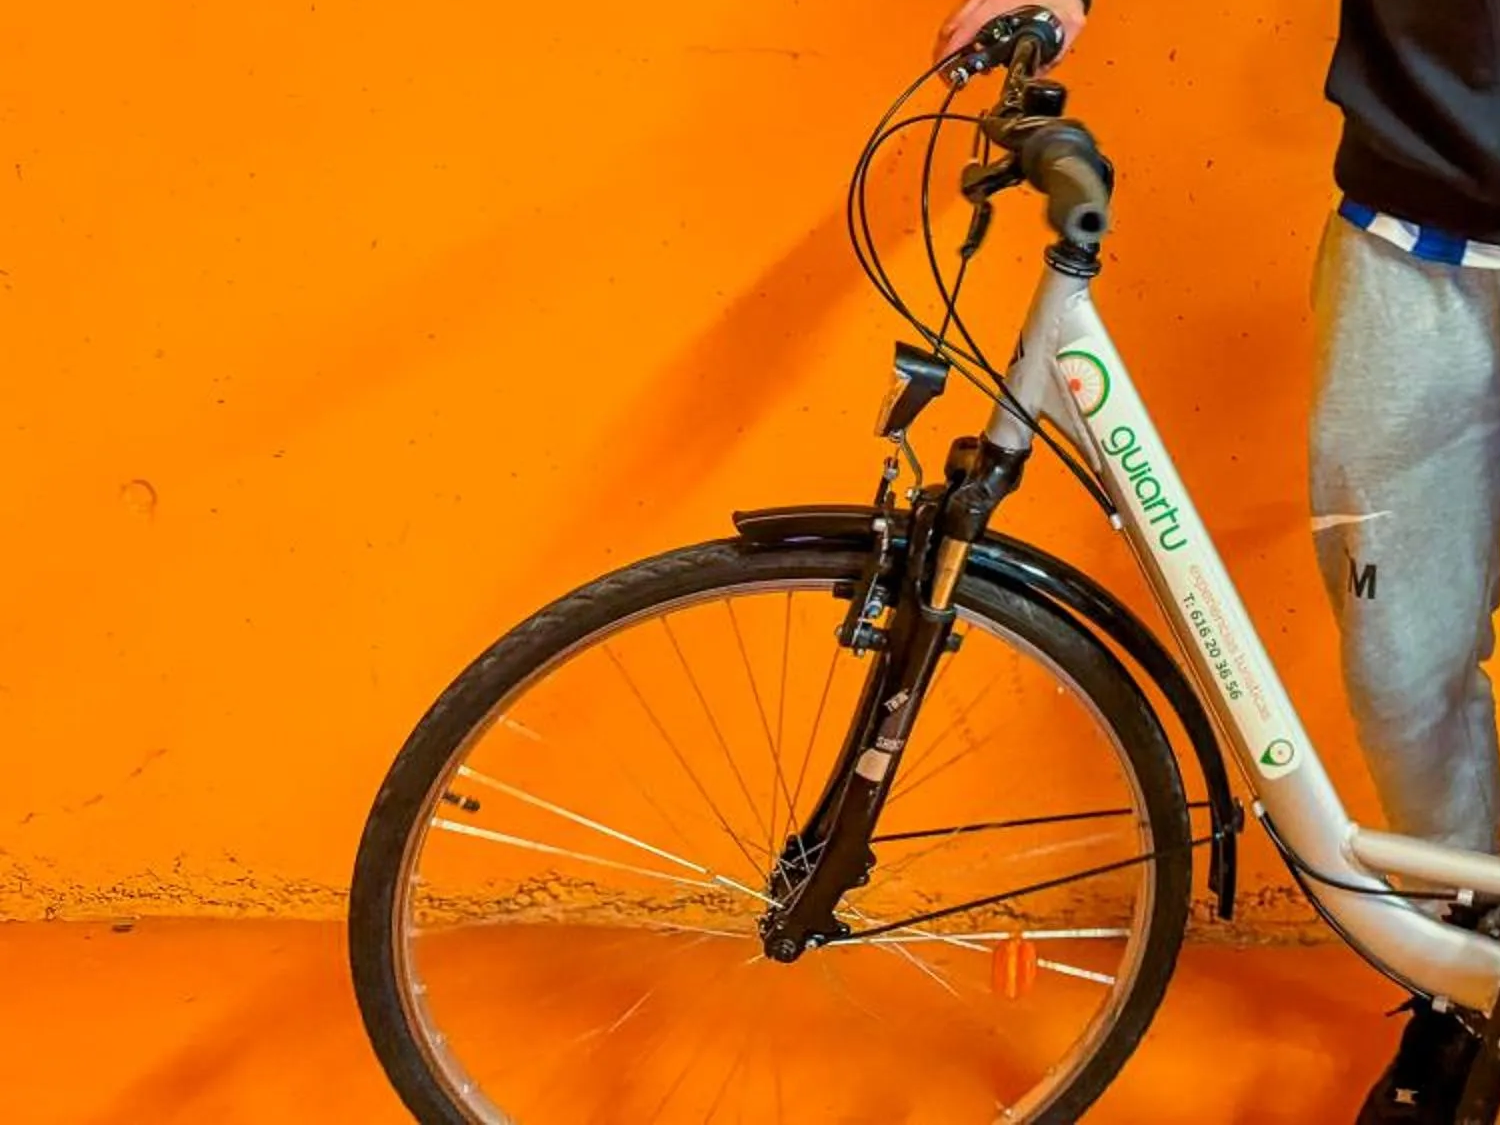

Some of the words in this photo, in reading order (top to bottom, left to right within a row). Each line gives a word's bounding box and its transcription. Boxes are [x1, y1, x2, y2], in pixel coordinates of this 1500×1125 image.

[1101, 425, 1188, 553] guiartu
[1183, 592, 1195, 609] T:
[1189, 610, 1212, 638] 616
[1204, 637, 1222, 660] 20
[1225, 680, 1244, 701] 56
